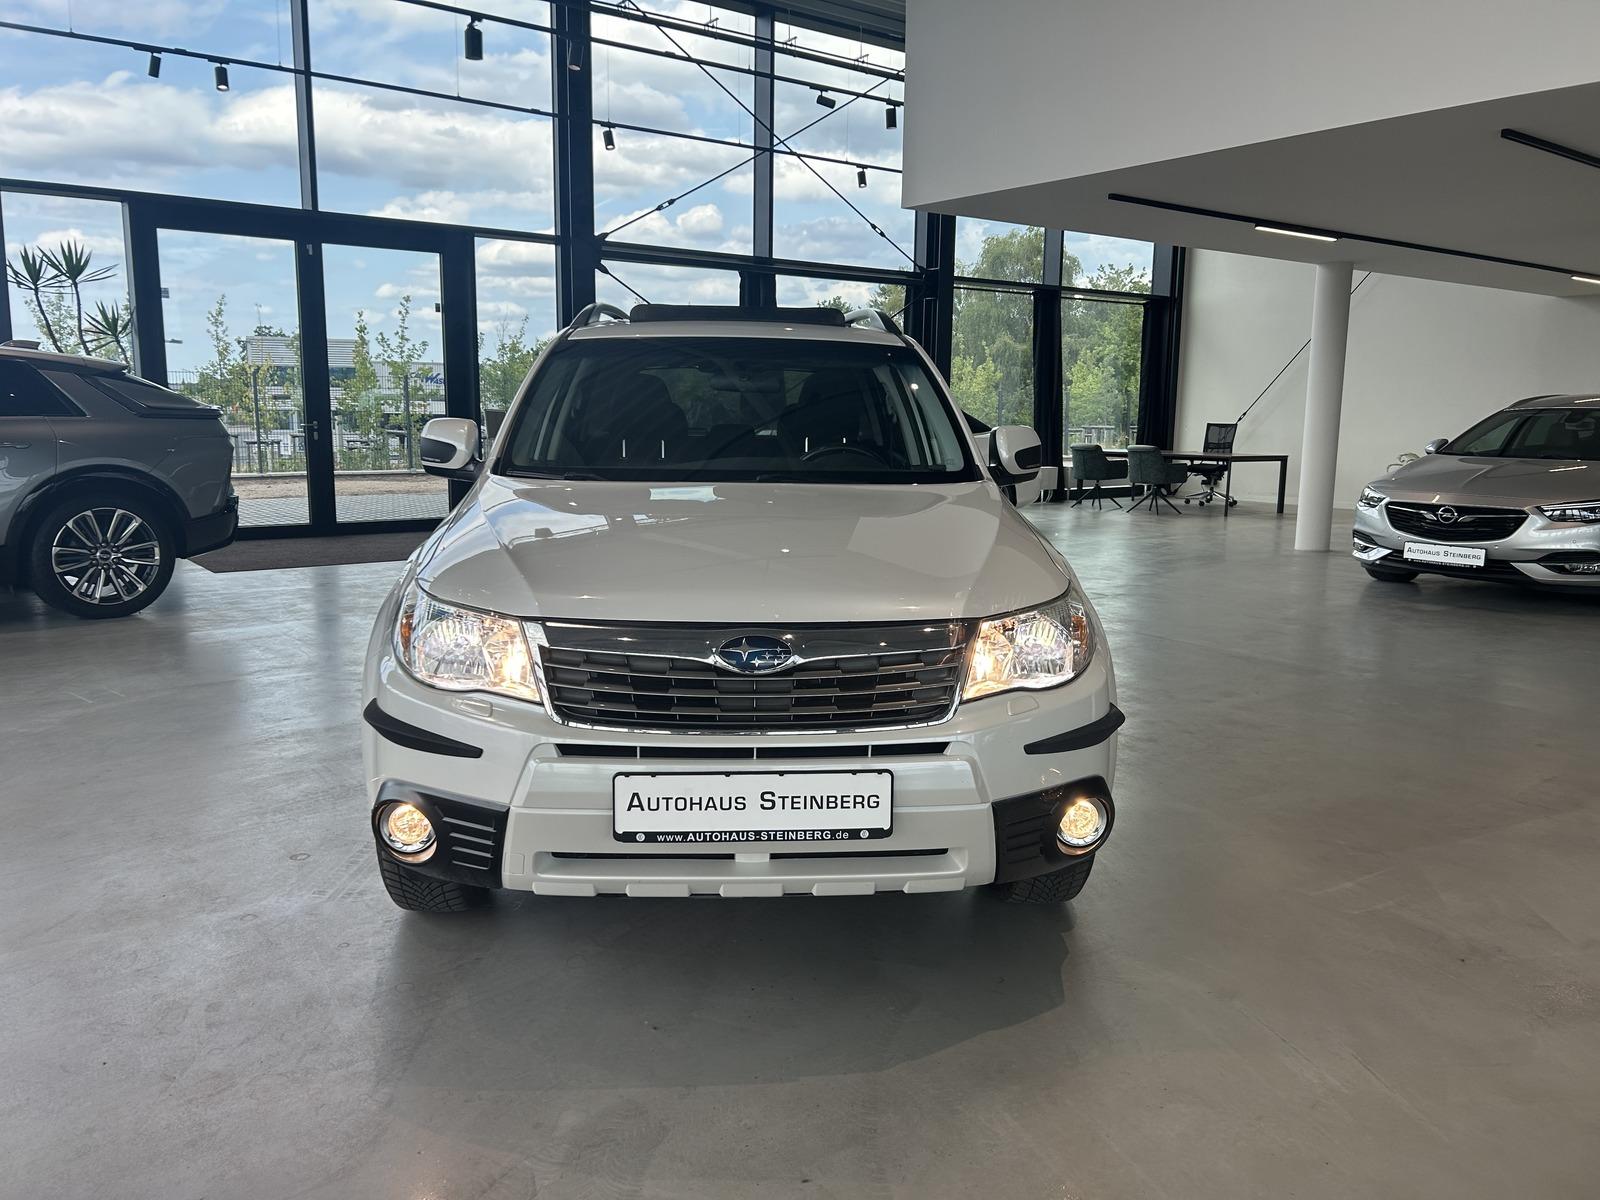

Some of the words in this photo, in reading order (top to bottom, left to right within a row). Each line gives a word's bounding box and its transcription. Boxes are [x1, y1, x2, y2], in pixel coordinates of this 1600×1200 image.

[424, 372, 445, 385] WAS
[1406, 546, 1441, 557] AUTOHAUS
[1443, 550, 1482, 561] STEINBERG
[626, 792, 747, 812] AUTOHAUS
[759, 790, 880, 811] STEINBERG
[656, 830, 849, 842] www.AUTOHAUS-STEINBERG.de
